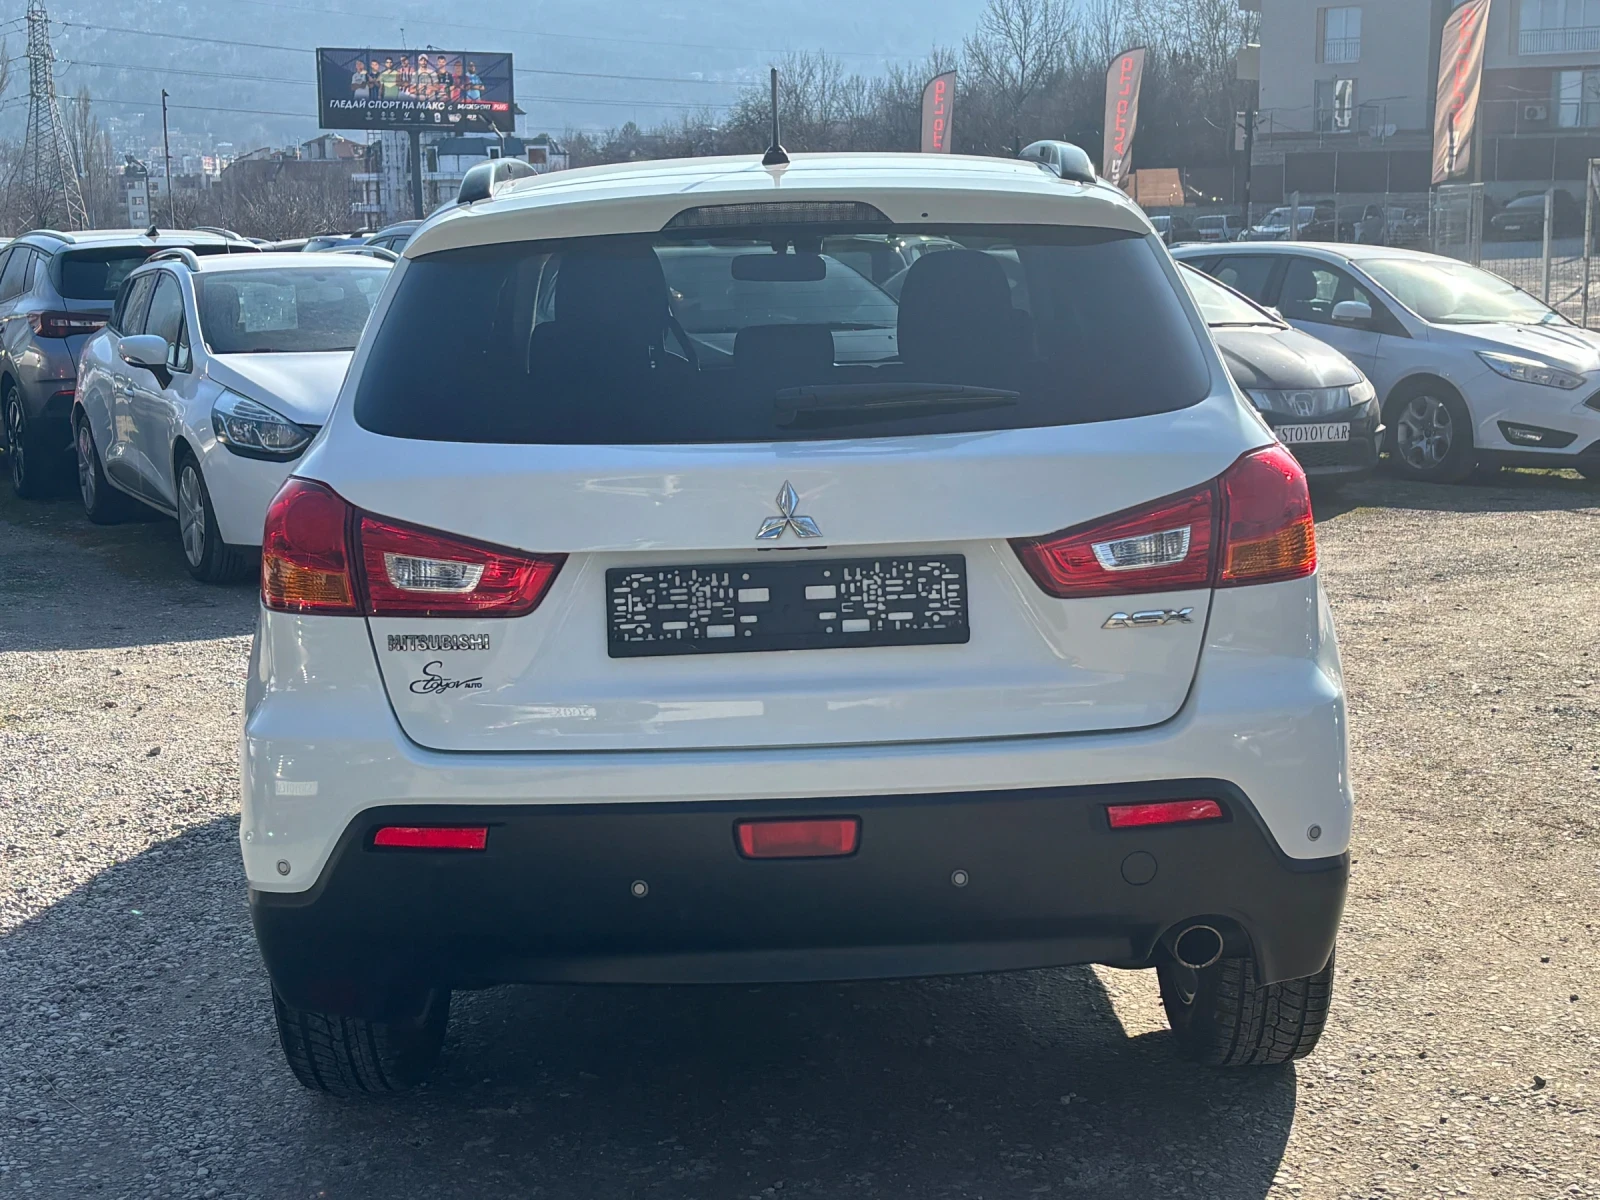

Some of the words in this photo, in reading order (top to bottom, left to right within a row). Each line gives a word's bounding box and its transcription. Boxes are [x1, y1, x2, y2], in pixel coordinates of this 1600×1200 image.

[1457, 8, 1475, 54] LTD
[1119, 57, 1133, 96] LTD
[329, 98, 366, 109] ГЛЕДАЙ
[367, 100, 401, 110] СПОРТ
[401, 101, 415, 110] НА
[416, 101, 446, 110] МАКС
[934, 80, 945, 115] LTD
[1113, 99, 1129, 154] AUTO
[1282, 425, 1325, 441] STOYOV
[1327, 425, 1348, 440] CAR
[1101, 607, 1195, 629] ASX
[387, 634, 490, 651] MITSUBISHI
